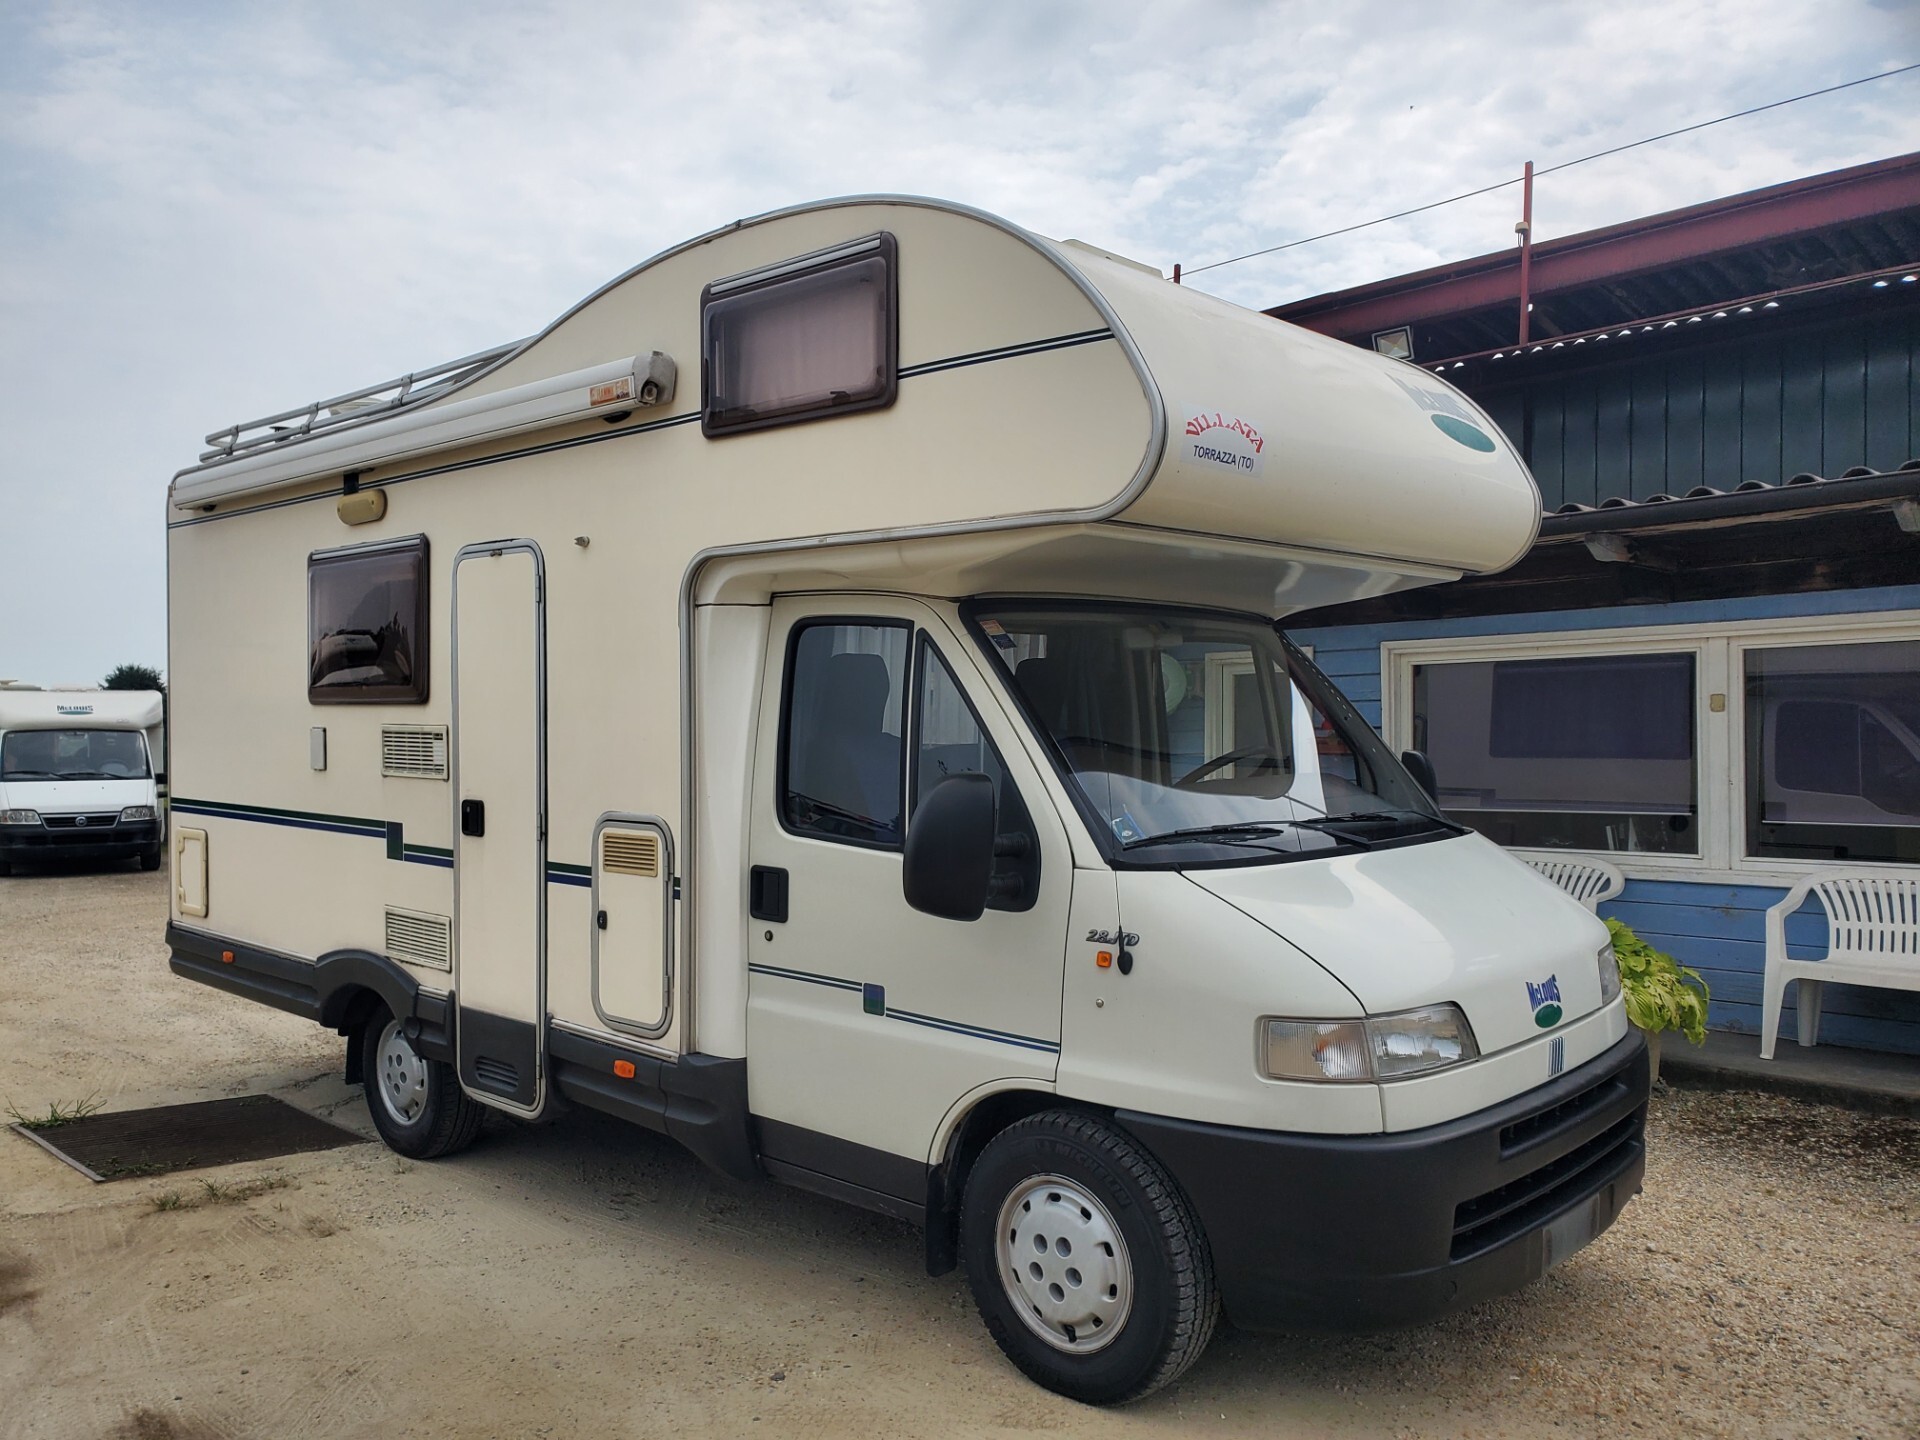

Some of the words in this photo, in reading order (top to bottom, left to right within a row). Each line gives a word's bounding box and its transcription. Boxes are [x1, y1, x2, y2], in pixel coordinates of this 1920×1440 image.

[1185, 413, 1264, 453] VILLATA
[1193, 445, 1236, 466] TORRAZZA
[1237, 456, 1254, 473] (TO)
